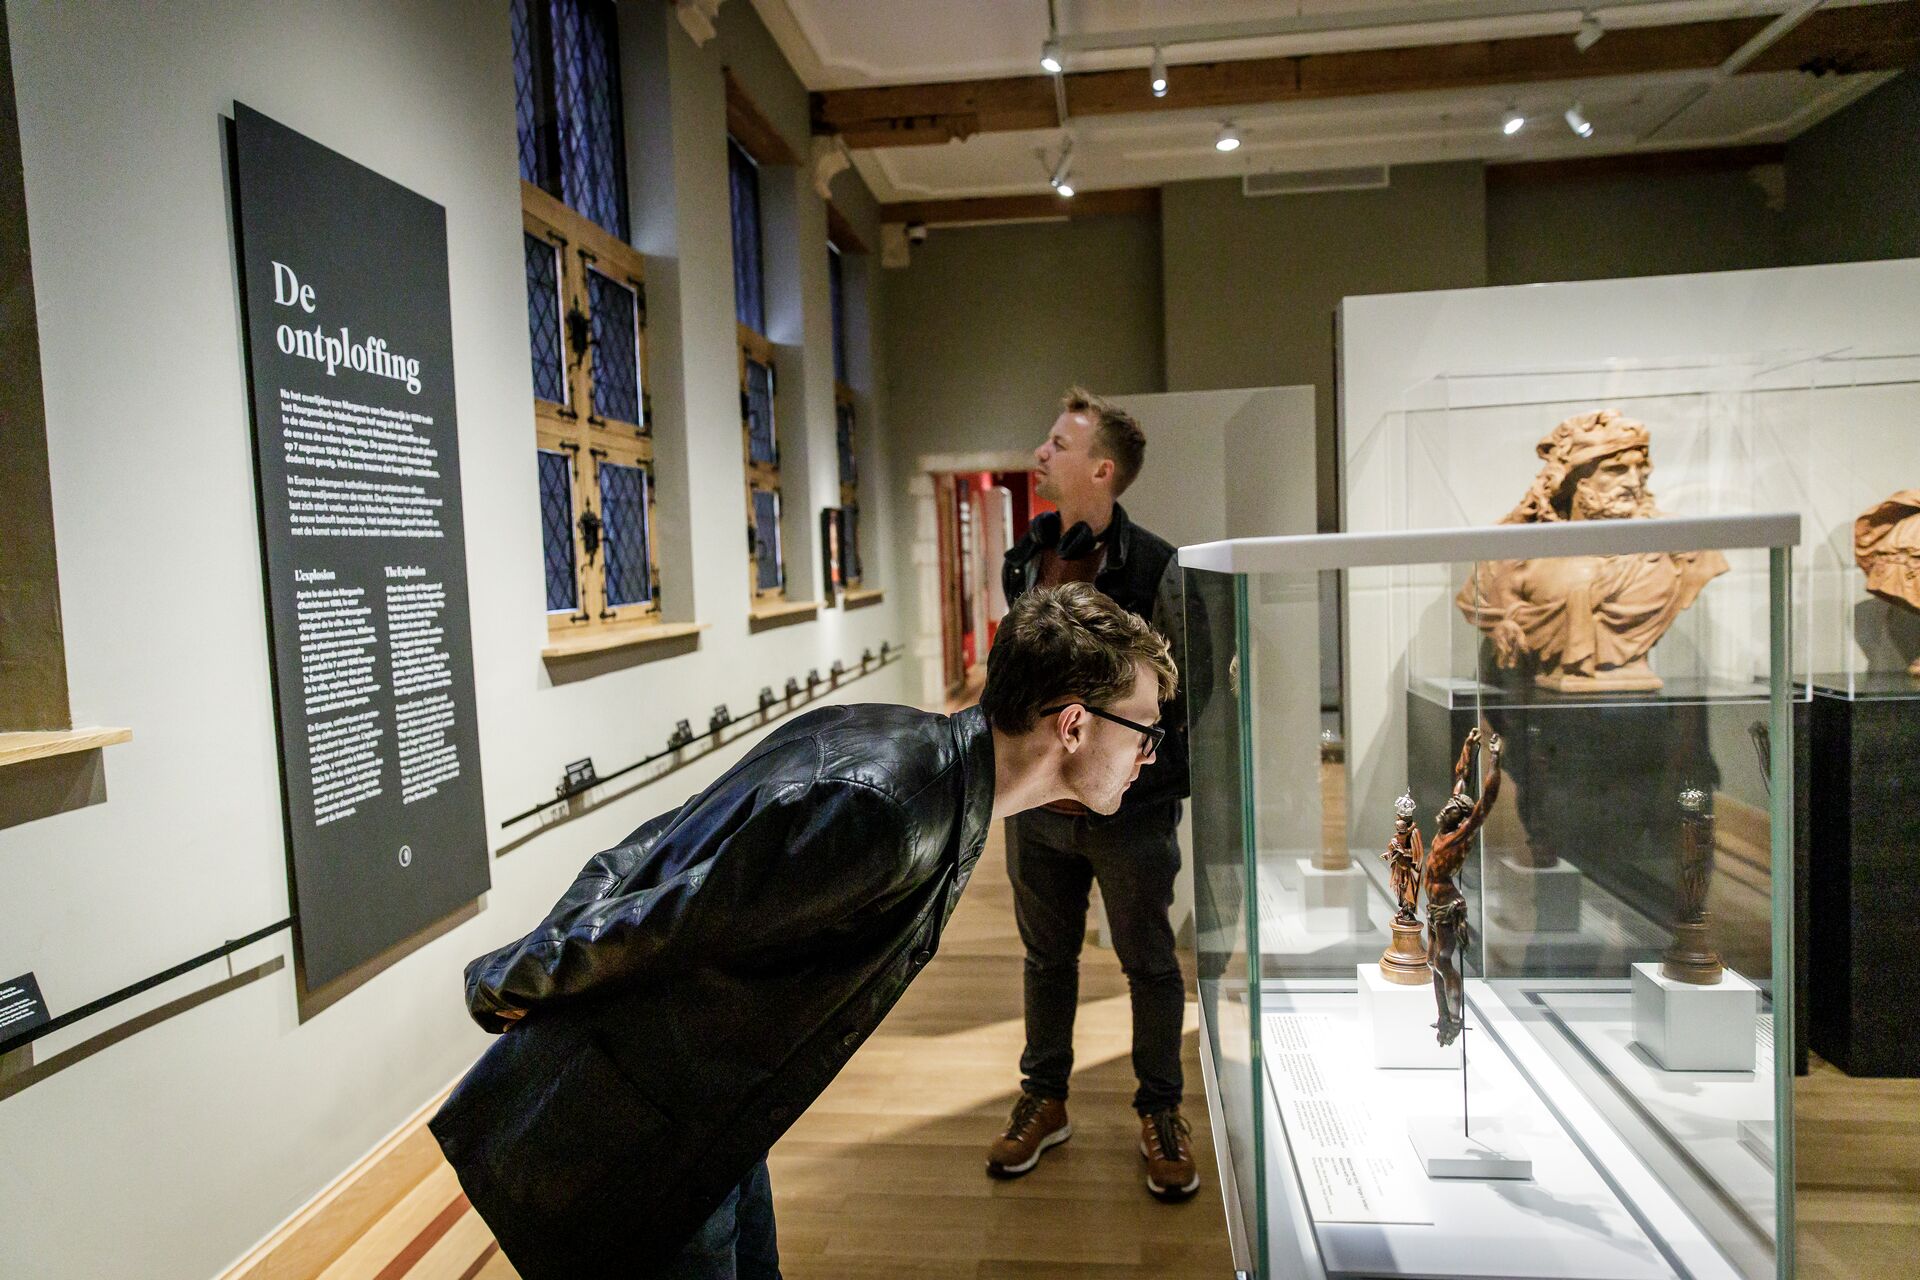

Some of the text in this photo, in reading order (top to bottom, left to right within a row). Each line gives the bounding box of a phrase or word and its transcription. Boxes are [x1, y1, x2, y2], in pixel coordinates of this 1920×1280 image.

[272, 261, 316, 313] De
[277, 325, 421, 395] ontploffing
[280, 389, 290, 399] Na
[290, 390, 301, 401] het
[281, 402, 292, 412] het
